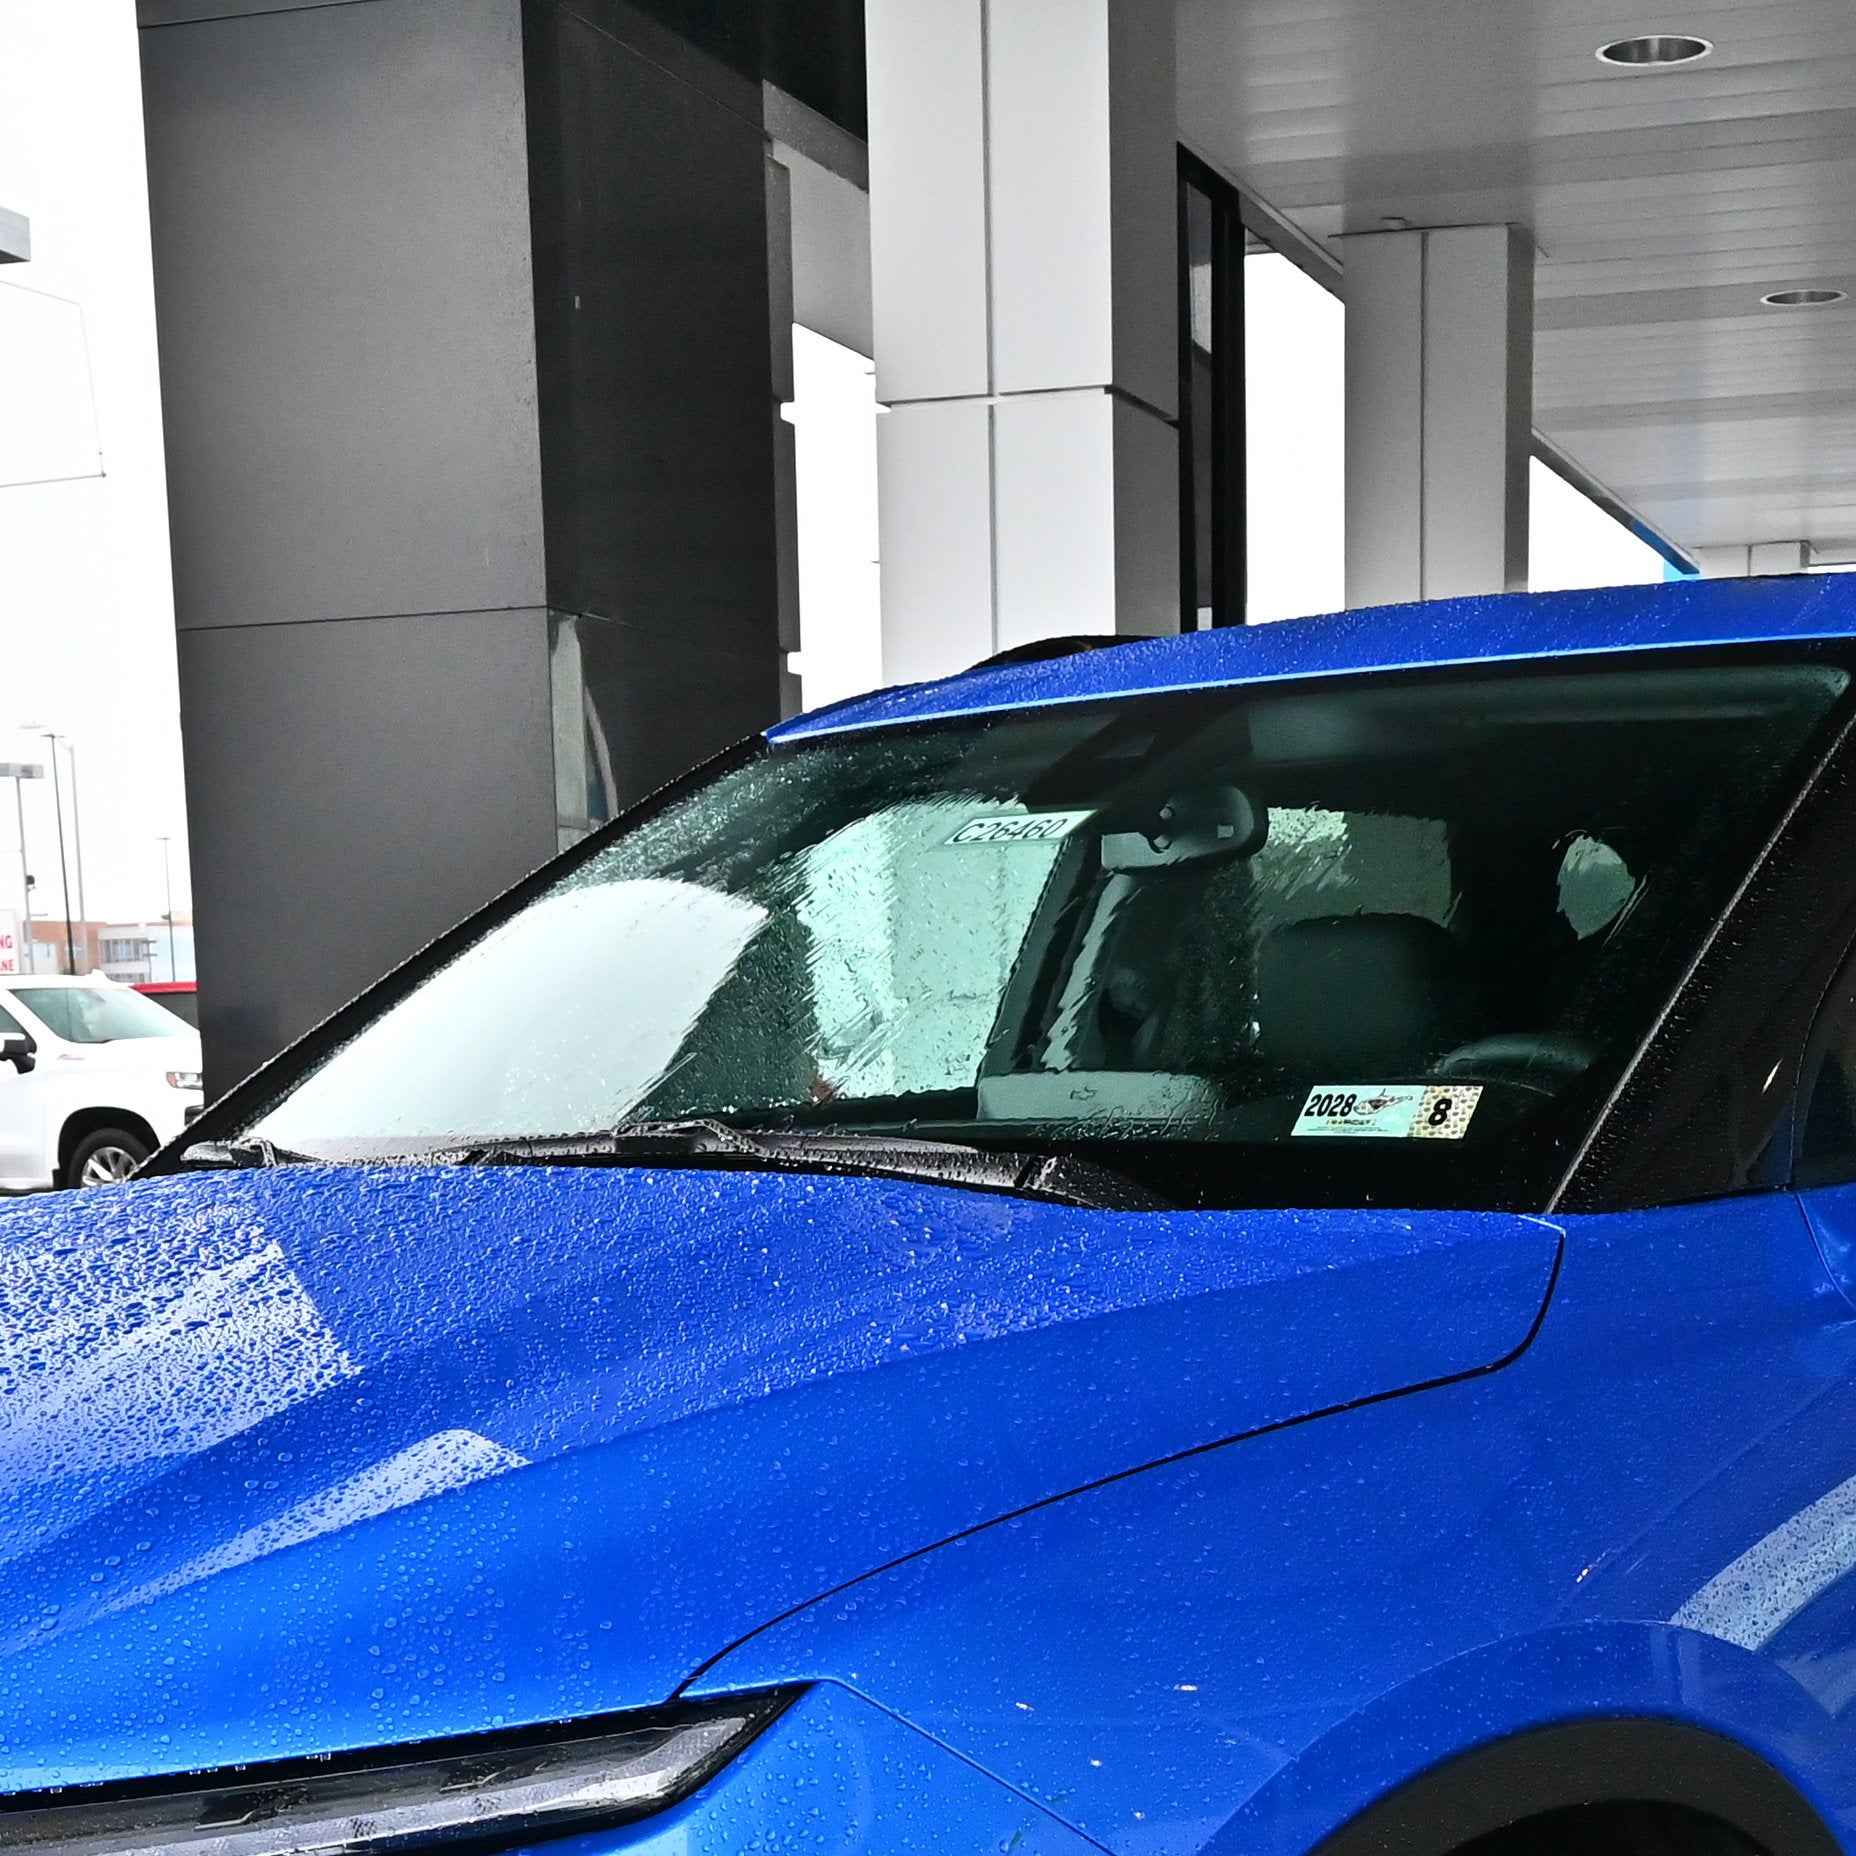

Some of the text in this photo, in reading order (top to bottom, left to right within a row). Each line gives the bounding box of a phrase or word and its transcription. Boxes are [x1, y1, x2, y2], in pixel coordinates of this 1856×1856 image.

[952, 818, 1069, 843] C26460
[1304, 1094, 1453, 1126] 2028 8
